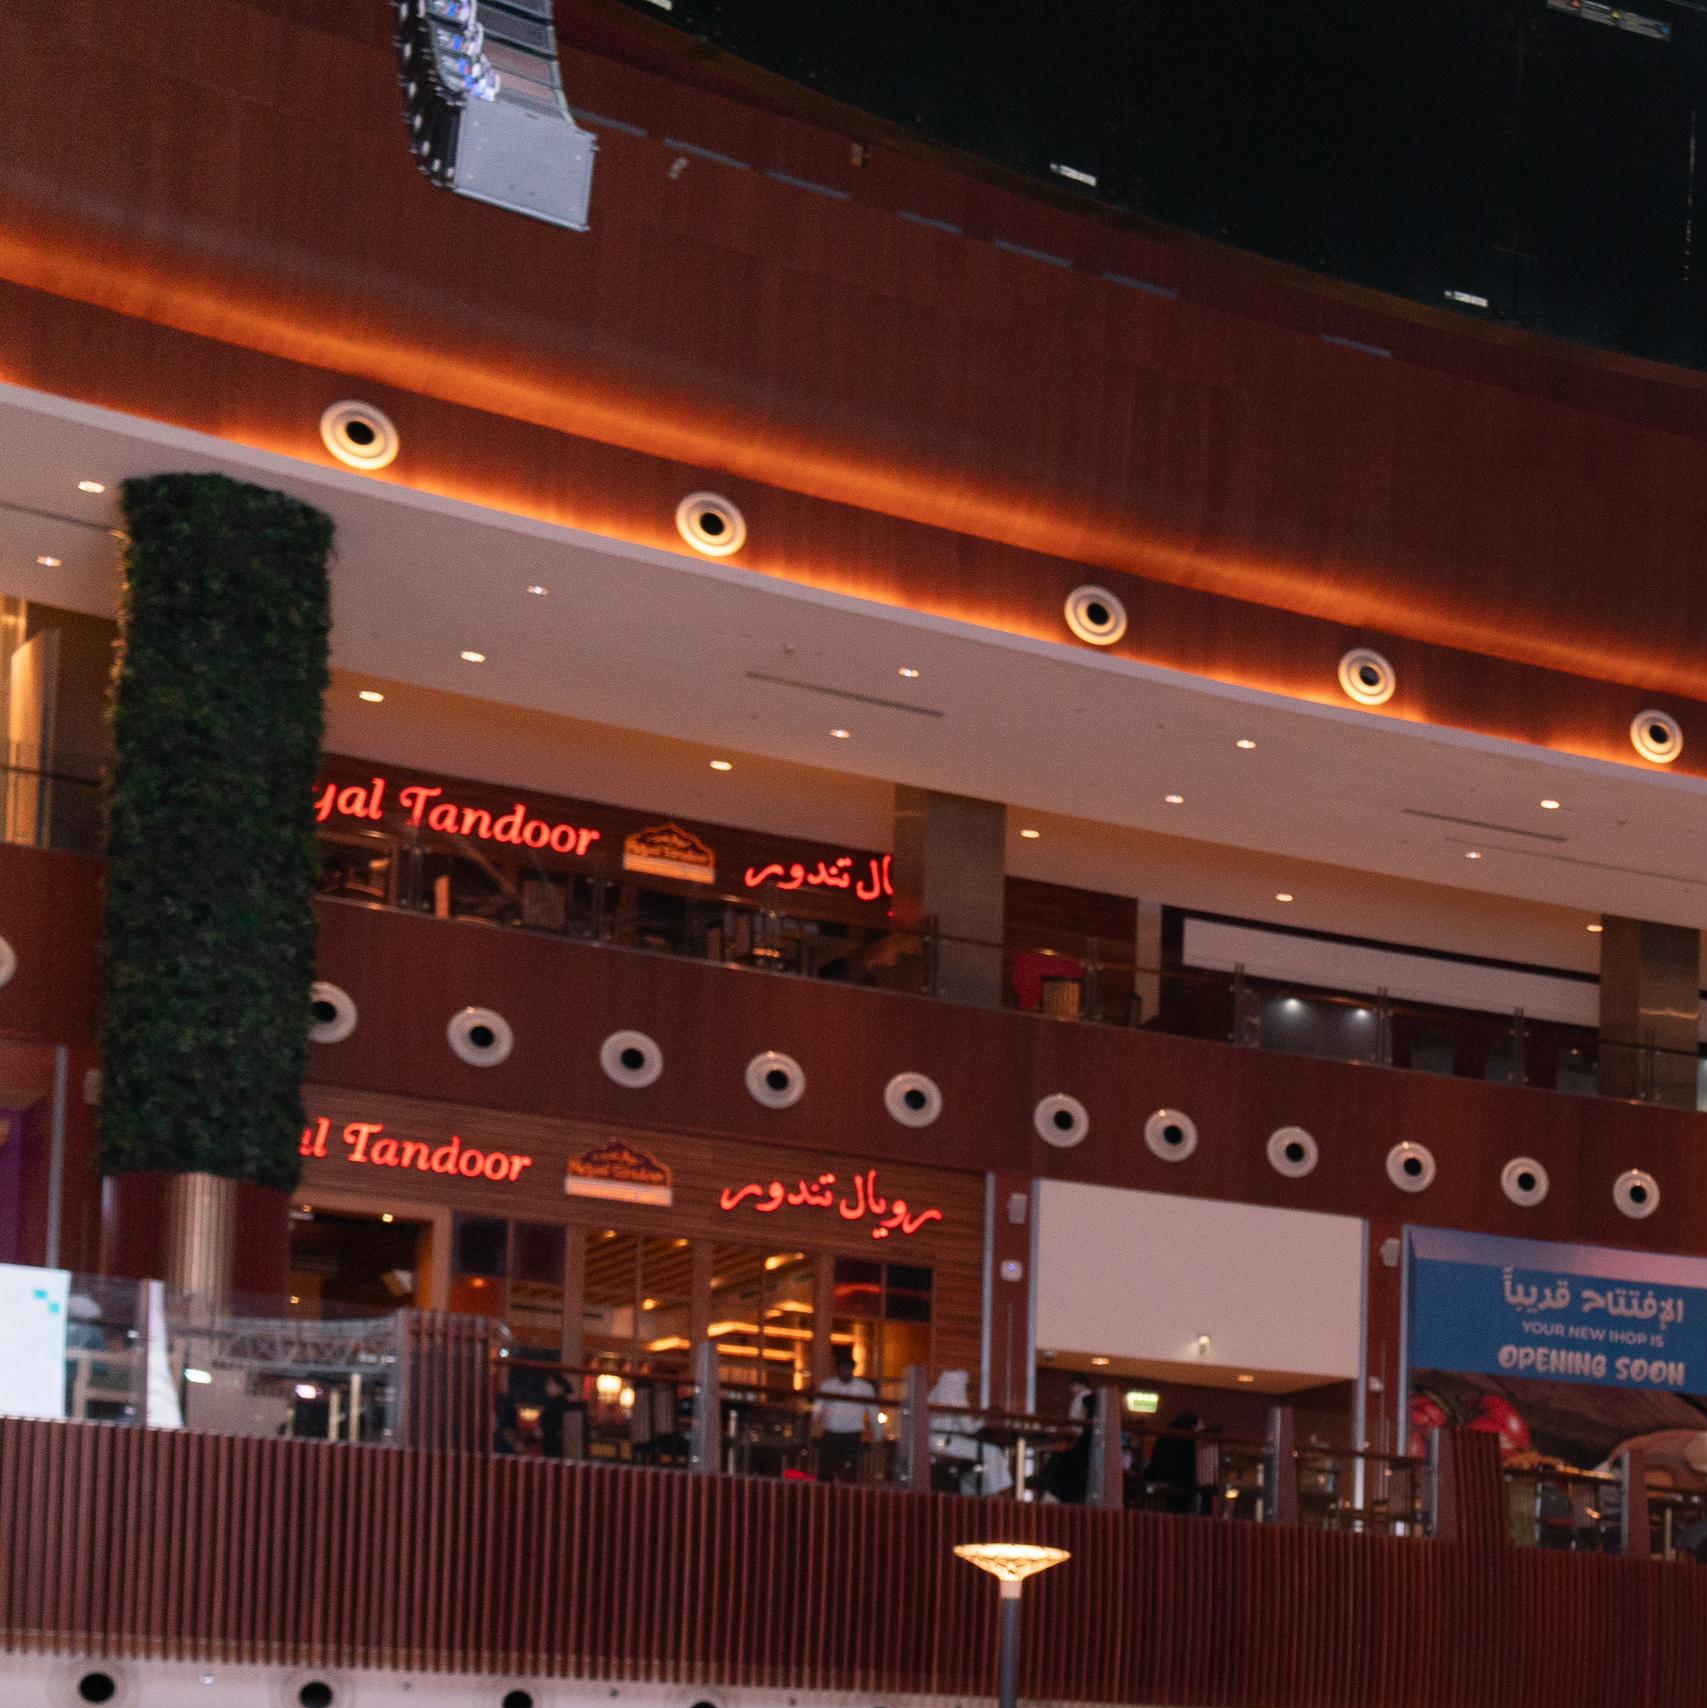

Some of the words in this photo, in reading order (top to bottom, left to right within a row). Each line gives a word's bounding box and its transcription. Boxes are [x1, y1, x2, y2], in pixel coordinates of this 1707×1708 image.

[399, 786, 600, 856] Tandoor
[342, 1122, 533, 1182] Tandoor
[719, 1173, 836, 1211] تندور
[838, 1169, 943, 1238] رويال
[1522, 1320, 1565, 1338] YOUR
[1568, 1326, 1606, 1342] NEW
[1609, 1331, 1647, 1346] IHOP
[1650, 1335, 1664, 1348] IS
[1498, 1344, 1607, 1380] OPENING
[1614, 1356, 1686, 1387] SOON
